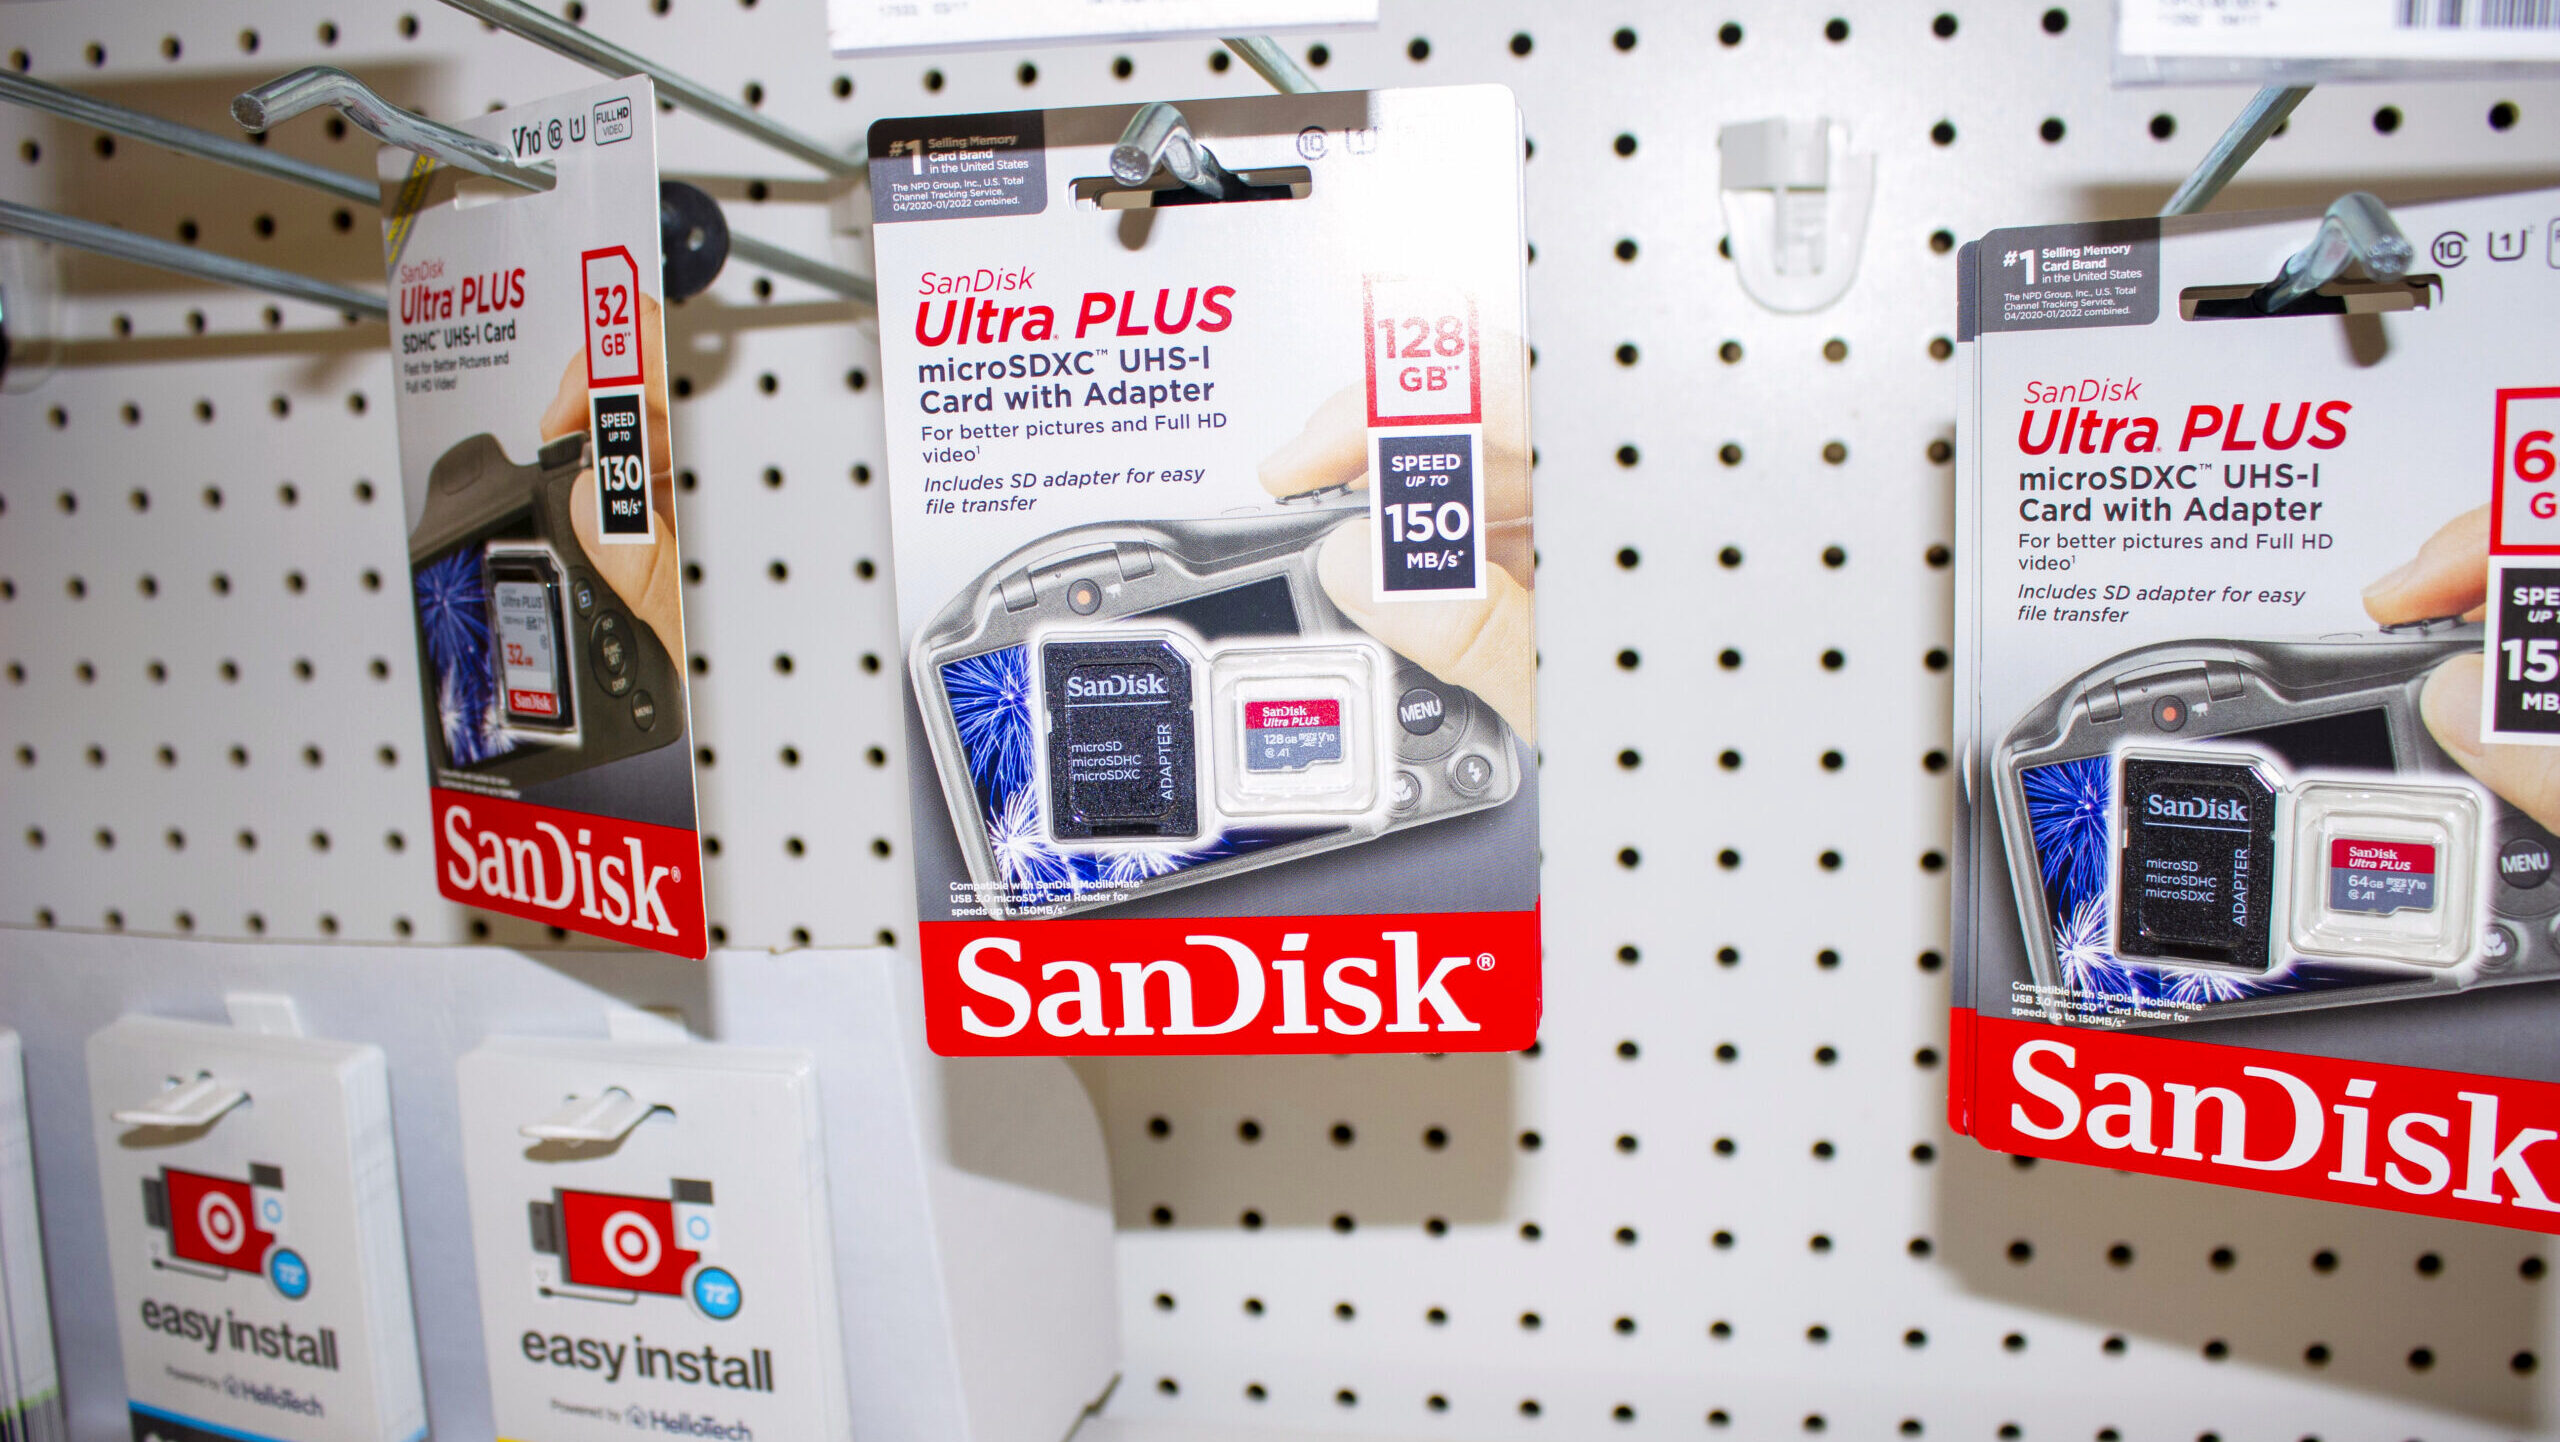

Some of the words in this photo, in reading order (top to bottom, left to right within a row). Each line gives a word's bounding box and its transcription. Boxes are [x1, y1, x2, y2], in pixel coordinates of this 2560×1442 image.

[602, 124, 624, 137] VIDEO
[889, 138, 923, 176] #1
[928, 137, 967, 149] Selling
[969, 135, 1018, 147] Memory
[928, 151, 957, 163] Card
[959, 149, 994, 161] Brand
[929, 164, 940, 175] in
[942, 163, 959, 174] the
[960, 161, 995, 173] United
[996, 159, 1029, 170] States
[892, 182, 908, 192] The
[910, 182, 930, 191] NPD
[983, 178, 1000, 187] U.S.
[1002, 176, 1024, 185] Total
[892, 192, 929, 202] Channel
[931, 190, 968, 201] Tracking
[970, 188, 1004, 198] Service,
[893, 200, 972, 212] 04/2020-01/2022
[974, 196, 1021, 207] combined.
[400, 260, 445, 284] SanDisk
[2002, 249, 2035, 285] #1
[2041, 247, 2081, 259] Selling
[2083, 244, 2132, 256] Memory
[2042, 260, 2069, 272] Card
[2072, 258, 2107, 270] Brand
[918, 266, 1036, 295] SanDisk
[2042, 274, 2051, 284] in
[2053, 273, 2071, 283] the
[2073, 271, 2107, 282] United
[2109, 269, 2143, 280] States
[460, 268, 526, 317] PLUS
[2004, 293, 2020, 302] The
[2022, 292, 2042, 300] NPD
[2114, 286, 2137, 295] Total
[594, 284, 629, 327] 32
[1075, 285, 1237, 339] PLUS
[2004, 302, 2040, 311] Channel
[2042, 299, 2079, 309] Tracking
[2004, 309, 2082, 321] 04/2020-01/2022
[2084, 306, 2131, 317] combined.
[444, 325, 481, 349] UHS-I
[484, 319, 517, 343] Card
[1377, 315, 1466, 360] 128
[420, 360, 432, 374] for
[433, 356, 457, 374] Better
[459, 354, 492, 371] Pictures
[493, 351, 509, 367] and
[1119, 345, 1210, 374] UHS-I
[920, 387, 993, 414] Card
[1004, 383, 1072, 408] with
[1083, 379, 1215, 409] Adapter
[2023, 377, 2143, 404] SanDisk
[600, 411, 636, 429] SPEED
[921, 426, 954, 442] For
[960, 422, 1020, 440] better
[1026, 418, 1105, 440] pictures
[1111, 415, 1148, 433] and
[1154, 414, 1191, 431] Full
[1197, 412, 1228, 429] HD
[2179, 400, 2353, 452] PLUS
[608, 431, 619, 442] UP
[620, 430, 631, 442] TO
[1391, 453, 1461, 472] SPEED
[600, 455, 643, 492] 130
[924, 474, 1004, 492] Includes
[1010, 472, 1038, 489] SD
[1043, 469, 1121, 489] adapter
[1126, 467, 1155, 486] for
[1160, 467, 1206, 484] easy
[1405, 475, 1427, 488] UP
[1429, 474, 1449, 487] TO
[2223, 462, 2319, 489] UHS-I
[925, 498, 956, 515] file
[961, 495, 1038, 514] transfer
[2019, 496, 2092, 522] Card
[2103, 496, 2172, 522] with
[2183, 495, 2323, 526] Adapter
[1384, 501, 1471, 543] 150
[2018, 533, 2050, 549] For
[2056, 533, 2116, 550] better
[2123, 533, 2203, 552] pictures
[2210, 533, 2248, 549] and
[2256, 533, 2293, 550] Full
[2301, 533, 2334, 550] HD
[2017, 584, 2097, 601] Includes
[2103, 585, 2131, 601] SD
[2136, 586, 2216, 605] adapter
[2222, 586, 2252, 603] for
[2257, 589, 2306, 606] easy
[2512, 586, 2560, 608] SPE
[2017, 605, 2047, 621] file
[2053, 606, 2130, 623] transfer
[2527, 609, 2552, 623] UP
[507, 643, 524, 667] 32
[2501, 638, 2560, 682] 15
[1067, 674, 1168, 697] SanDisk
[514, 692, 551, 712] SanDisk
[634, 705, 653, 717] MENU
[1262, 706, 1307, 717] SanDisk
[1400, 699, 1441, 723] MENU
[1263, 717, 1289, 727] Ultra
[1291, 716, 1320, 726] PLUS
[1071, 741, 1122, 753] microSD
[1072, 754, 1143, 767] microSDHC
[1157, 723, 1173, 800] ADAPTER
[1073, 769, 1141, 782] microSDXC
[2149, 794, 2248, 822] SanDisk
[2349, 846, 2398, 860] SanDisk
[2501, 852, 2550, 873] MENU
[2146, 859, 2199, 872] microSD
[2349, 858, 2377, 869] Ultra
[2379, 860, 2412, 871] PLUS
[950, 881, 1009, 892] Compatible
[1011, 880, 1034, 890] with
[2145, 873, 2217, 888] microSDHC
[2232, 848, 2249, 927] ADAPTER
[950, 893, 972, 904] USB
[1047, 892, 1072, 902] Card
[1075, 892, 1111, 902] Reader
[1113, 891, 1129, 901] for
[2145, 888, 2215, 903] microSDXC
[951, 906, 988, 917] speeds
[991, 907, 1003, 917] up
[1005, 906, 1016, 915] to
[2011, 1039, 2560, 1213] SanDisk
[142, 1298, 224, 1354] easy
[227, 1309, 340, 1371] install
[521, 1330, 627, 1383] easy
[634, 1336, 774, 1393] install
[651, 1409, 754, 1442] HelloTech
